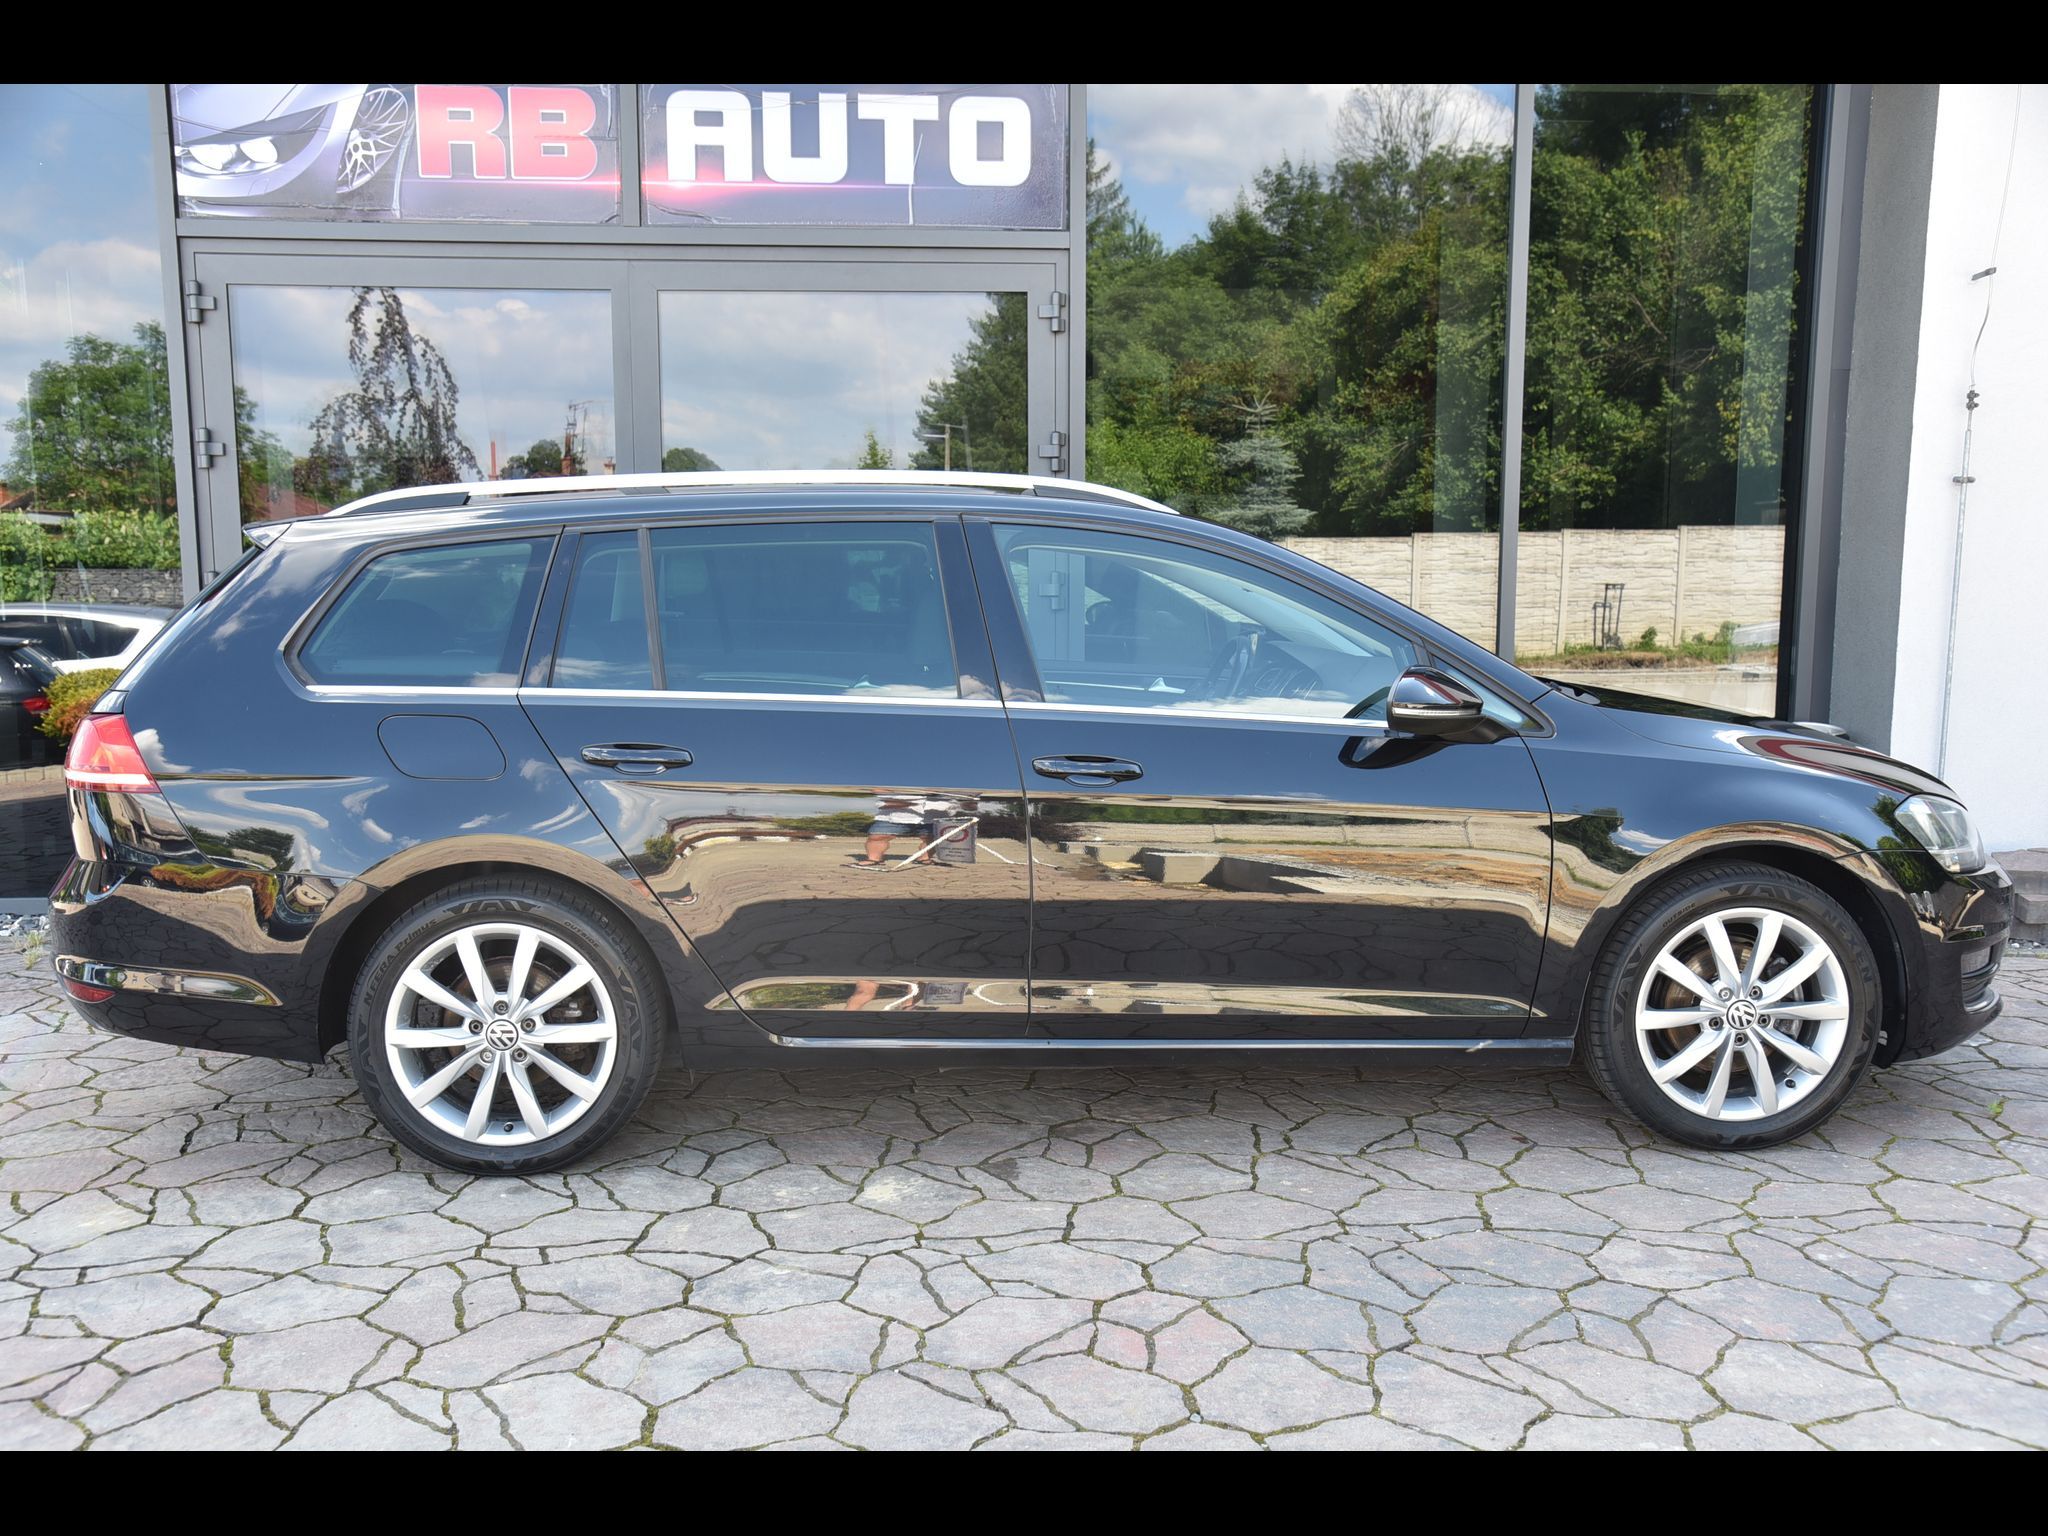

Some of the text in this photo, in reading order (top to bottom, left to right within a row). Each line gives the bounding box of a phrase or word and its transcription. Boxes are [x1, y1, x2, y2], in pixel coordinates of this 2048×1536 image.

[414, 84, 1031, 186] RB AUTO
[564, 921, 600, 949] OUTSIDE
